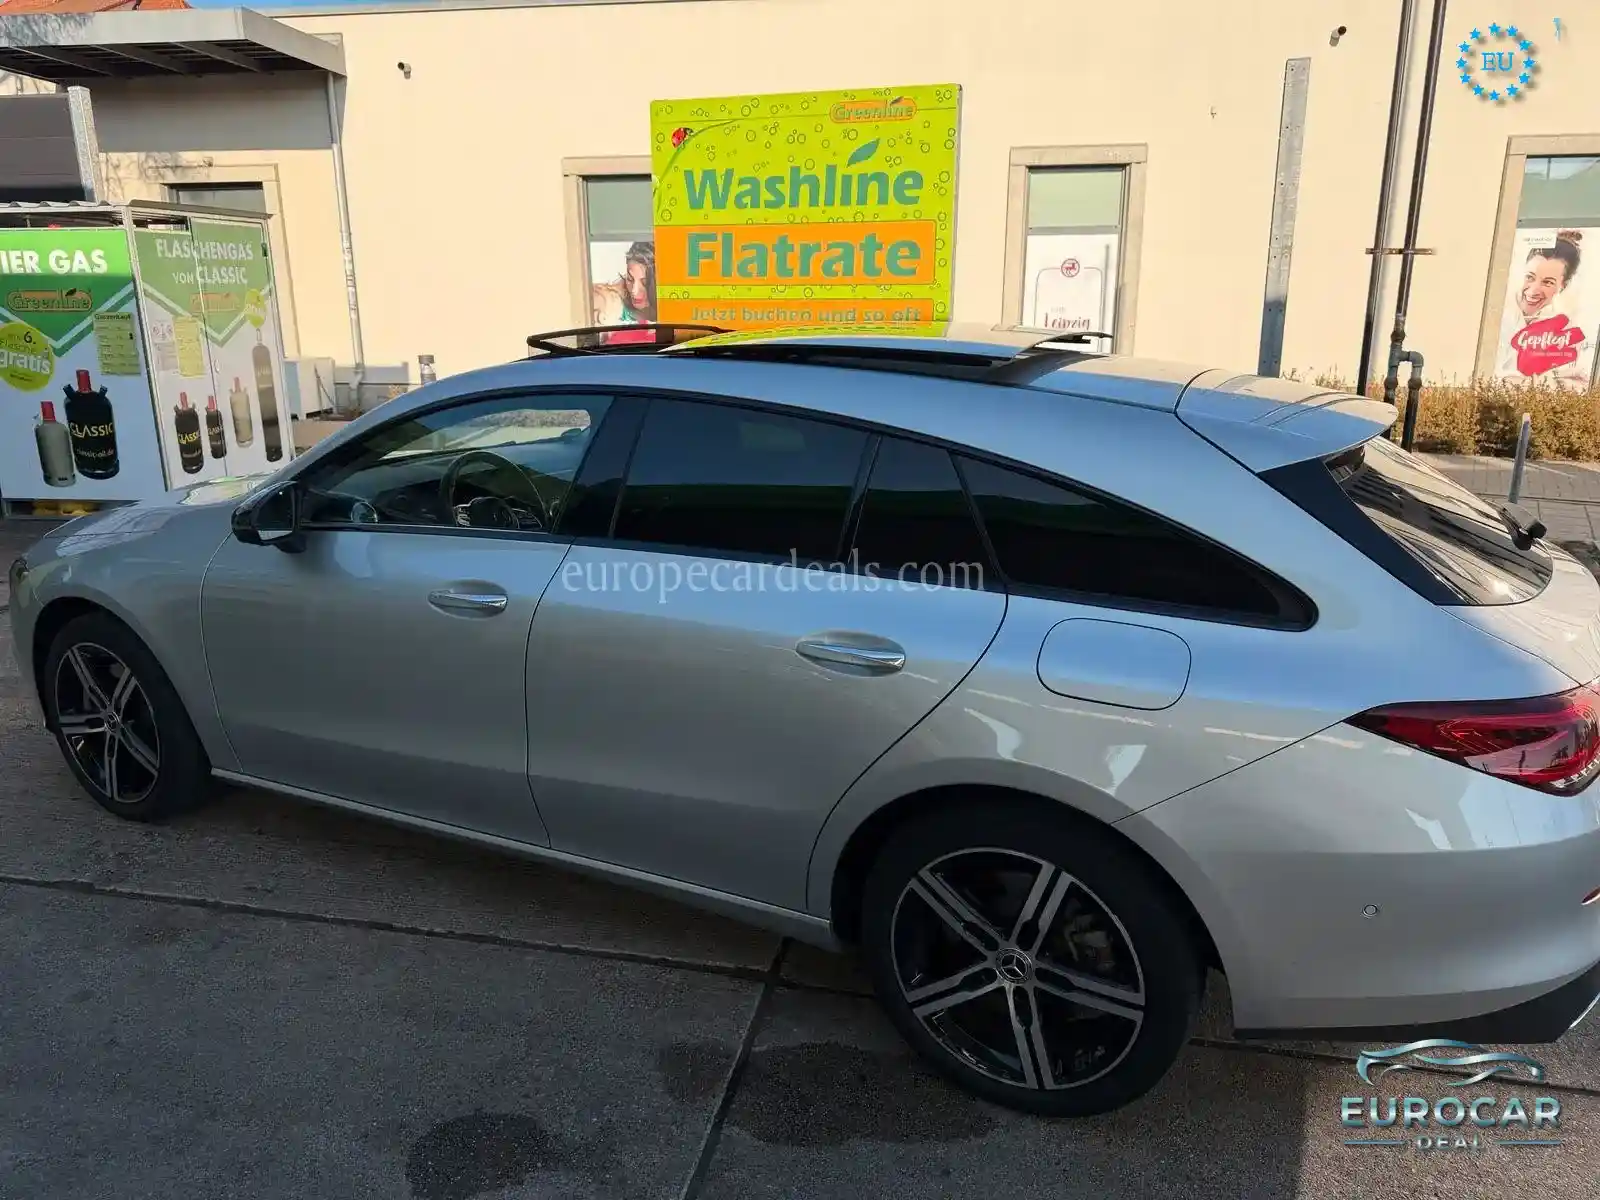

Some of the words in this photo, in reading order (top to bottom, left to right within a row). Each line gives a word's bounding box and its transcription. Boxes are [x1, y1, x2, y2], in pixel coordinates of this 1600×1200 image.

[833, 98, 915, 120] Greenline
[683, 162, 924, 211] Washline
[155, 238, 254, 261] FLASCHENGAS
[686, 230, 922, 278] Flatrate
[48, 249, 108, 275] GAS
[172, 271, 194, 285] VON
[196, 265, 248, 284] CLASSIC
[691, 307, 737, 321] Jetzt
[742, 306, 812, 321] buchen
[818, 307, 857, 323] und
[864, 310, 885, 322] so
[891, 307, 922, 323] oft
[1044, 312, 1091, 331] Leipzig
[1517, 330, 1572, 350] Gepflegt
[69, 421, 114, 438] CLASSIC
